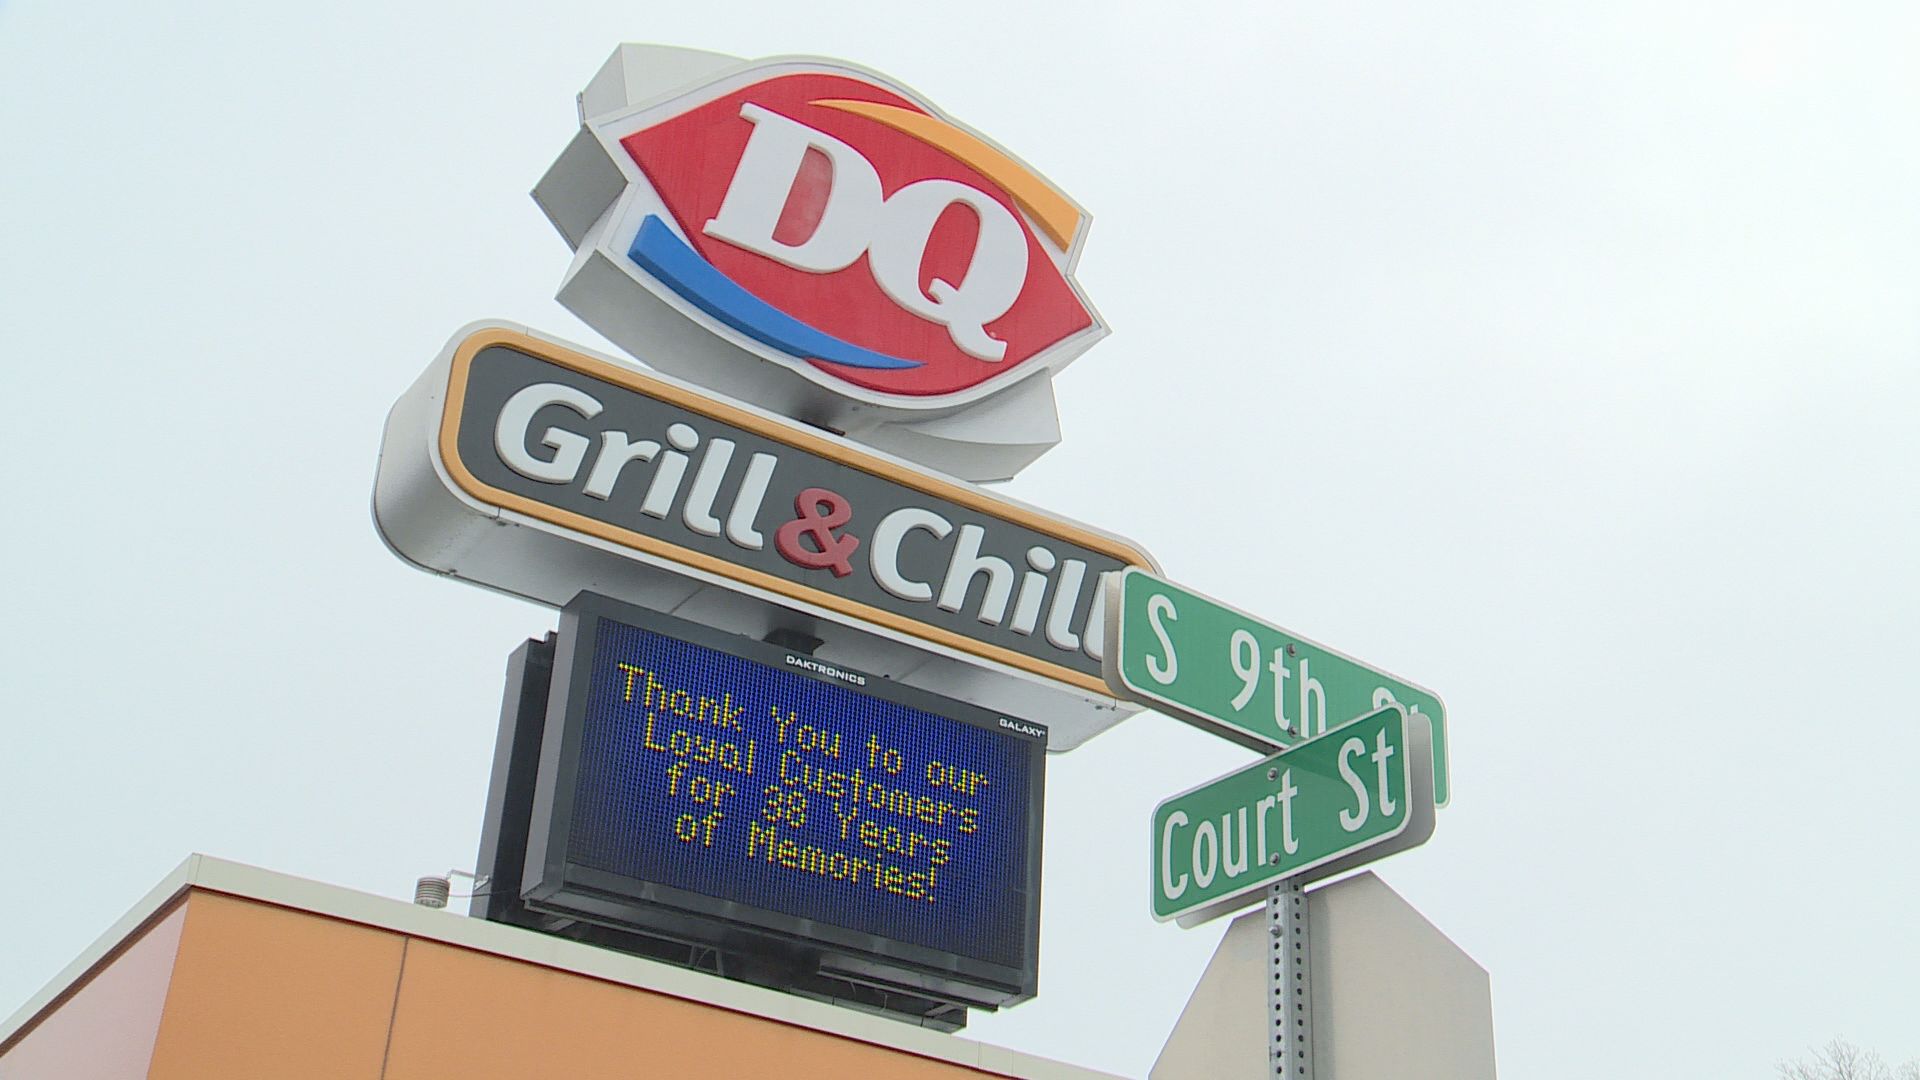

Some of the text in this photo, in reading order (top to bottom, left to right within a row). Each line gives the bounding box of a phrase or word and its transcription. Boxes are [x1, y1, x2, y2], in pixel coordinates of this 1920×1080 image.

[703, 102, 1029, 363] DQ
[494, 382, 779, 550] Grill
[774, 488, 858, 578] &
[619, 662, 989, 796] Thank You to our
[785, 655, 866, 686] DAKTRONICS
[1145, 594, 1327, 739] S 9th
[644, 712, 979, 835] Loyal Customers
[666, 760, 951, 866] for 38 Years
[1161, 727, 1396, 900] Court St
[674, 810, 937, 904] of Memories!
